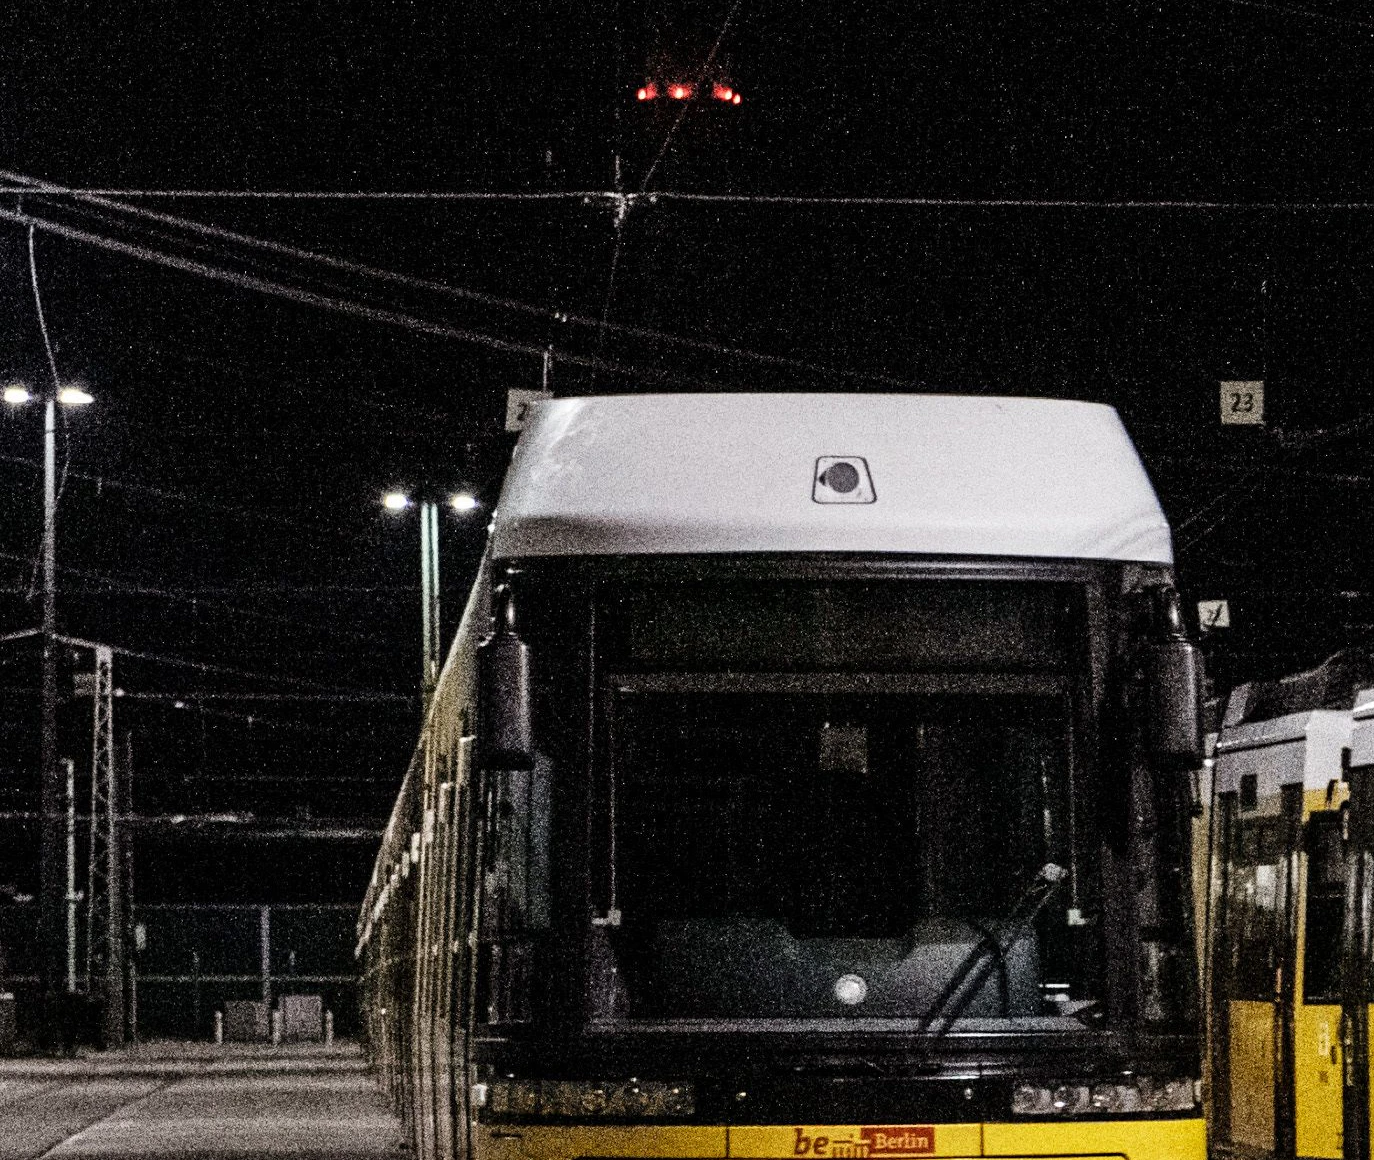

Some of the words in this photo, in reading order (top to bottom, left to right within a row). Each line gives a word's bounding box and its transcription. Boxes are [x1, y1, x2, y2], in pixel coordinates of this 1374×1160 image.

[1230, 392, 1254, 413] 23
[794, 1127, 829, 1156] be
[875, 1131, 930, 1150] Berlin
